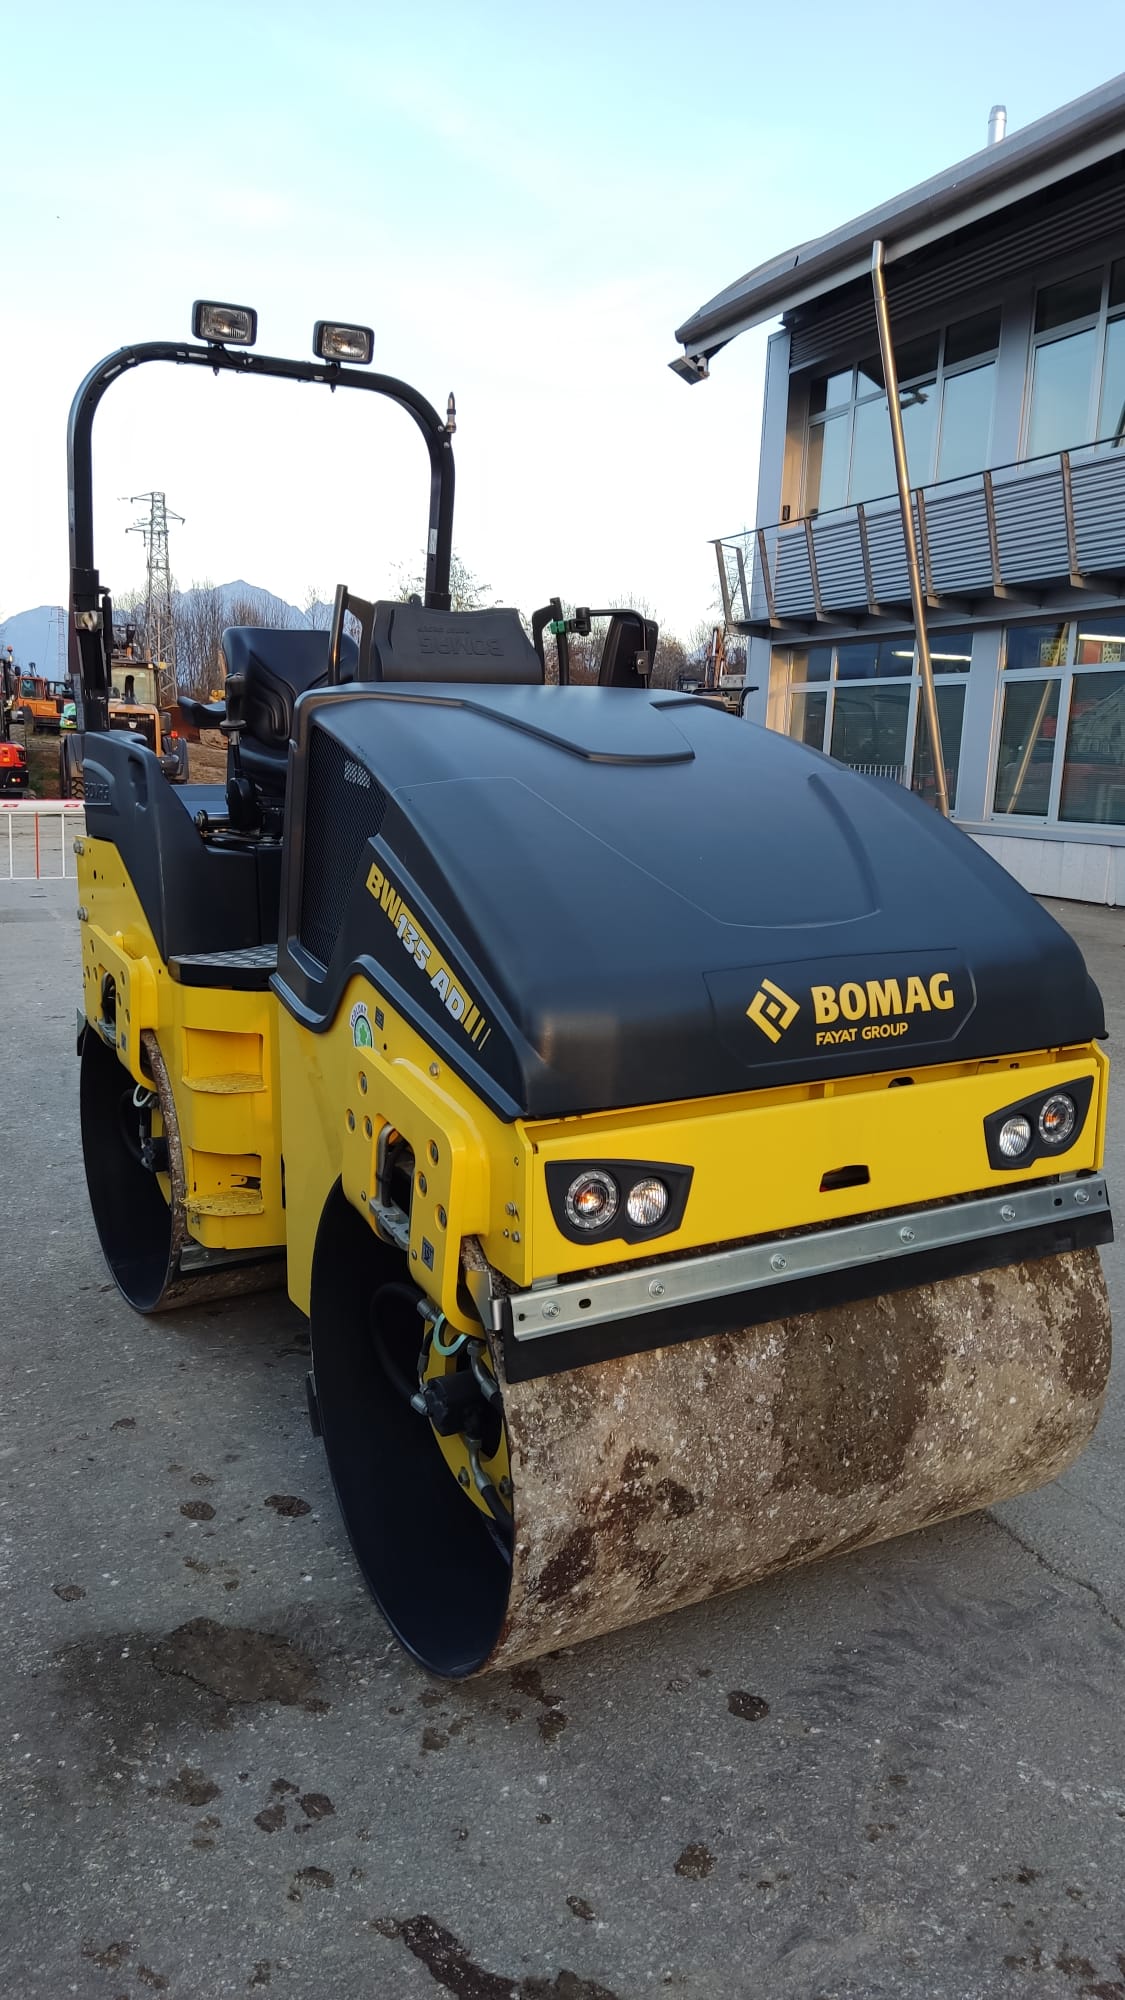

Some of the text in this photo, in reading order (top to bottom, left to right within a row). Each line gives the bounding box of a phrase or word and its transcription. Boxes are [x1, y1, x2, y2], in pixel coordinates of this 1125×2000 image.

[430, 968, 466, 1021] AD
[810, 972, 955, 1025] BOMAG
[816, 1022, 909, 1046] FAYAT GROUP
